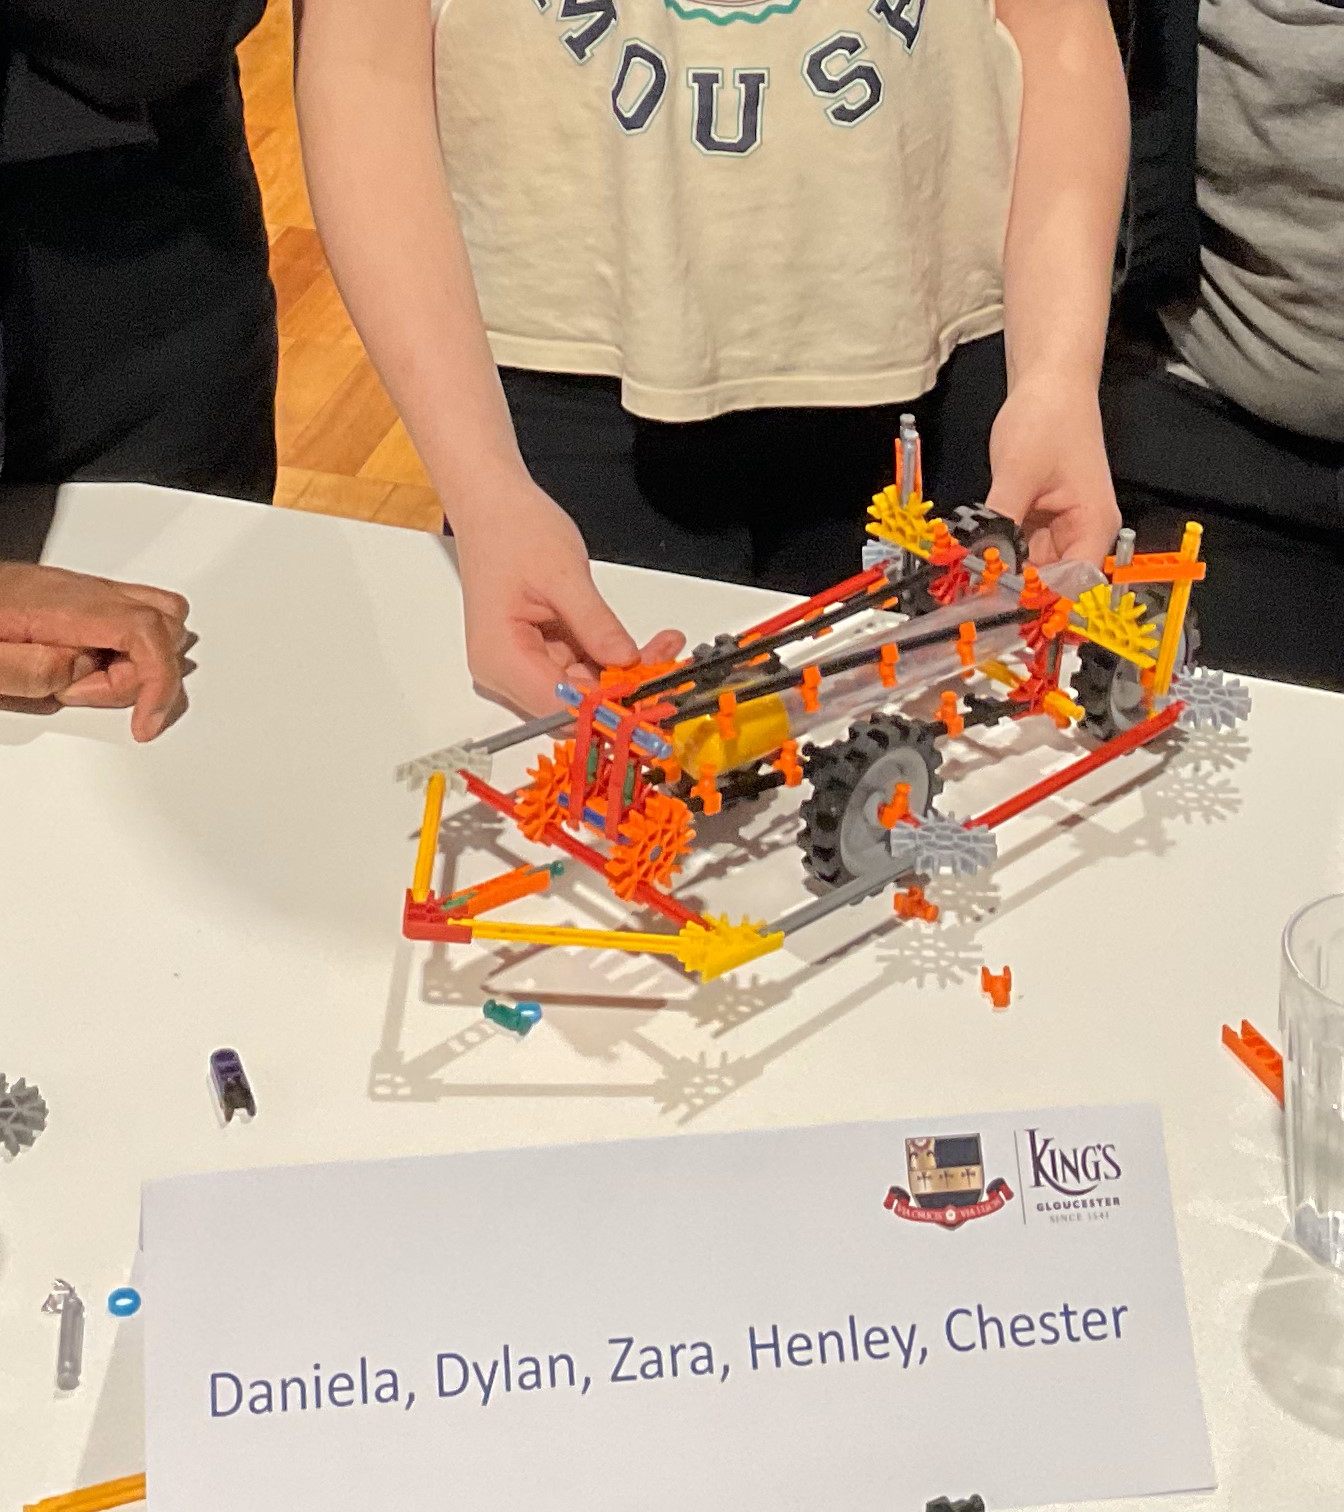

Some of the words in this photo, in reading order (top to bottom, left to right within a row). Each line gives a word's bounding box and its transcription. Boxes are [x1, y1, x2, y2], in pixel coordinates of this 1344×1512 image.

[1036, 1196, 1120, 1212] GLOUCESTER
[1050, 1212, 1083, 1224] SINCE
[209, 1356, 416, 1418] Daniela,
[436, 1344, 592, 1407] Dylan,
[608, 1336, 731, 1383] Zara,
[748, 1314, 929, 1370] Henley,
[944, 1302, 1129, 1352] Chester
